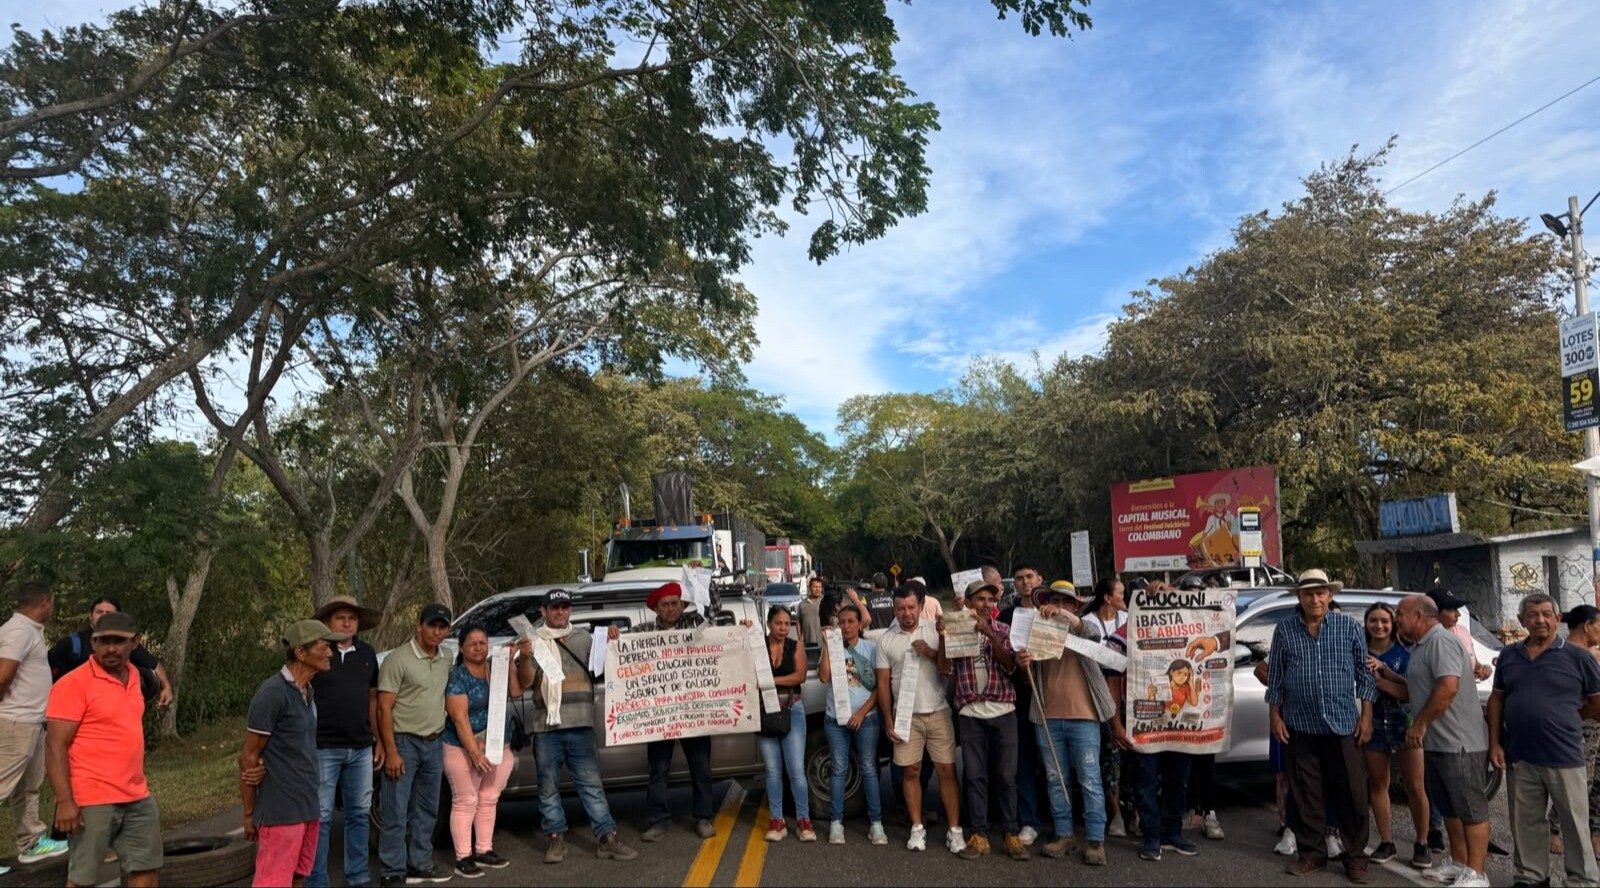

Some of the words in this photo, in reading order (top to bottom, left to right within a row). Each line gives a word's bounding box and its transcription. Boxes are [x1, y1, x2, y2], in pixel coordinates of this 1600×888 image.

[1562, 328, 1594, 348] LOTES
[1564, 349, 1585, 366] 300
[1570, 378, 1593, 404] 59
[1131, 503, 1163, 512] Bienvenidos
[1118, 513, 1149, 524] CAPITAL
[1150, 508, 1190, 521] MUSICAL,
[1134, 523, 1143, 531] del
[1144, 522, 1164, 530] Festival
[1128, 529, 1181, 542] COLOMBIANO
[1136, 591, 1206, 607] CHUCUNI
[1136, 612, 1184, 627] ¡BASTA
[1136, 627, 1153, 639] DE
[1157, 622, 1206, 638] ABUSOS!
[617, 640, 629, 653] LA
[631, 634, 666, 651] ENERGÍA
[668, 635, 679, 645] ES
[682, 633, 694, 643] UN
[661, 647, 673, 659] NO
[674, 646, 684, 655] UN
[687, 644, 724, 655] PRIVILEGIO
[616, 662, 655, 679] CELSIA:
[656, 657, 693, 671] CHUCUNI
[695, 656, 719, 667] EXIGE
[625, 678, 639, 691] UN
[640, 671, 678, 687] SERVICIO
[625, 687, 658, 702] SEGURO
[660, 684, 667, 694] Y
[671, 683, 682, 692] DE
[685, 677, 720, 689] CALIDAD
[654, 695, 673, 707] PARA
[675, 691, 706, 703] NUESTRA
[617, 710, 650, 725] EXIGIMOS
[652, 703, 690, 717] SOLUCIONES
[633, 717, 666, 730] COMUNIDAD
[669, 714, 678, 722] DE
